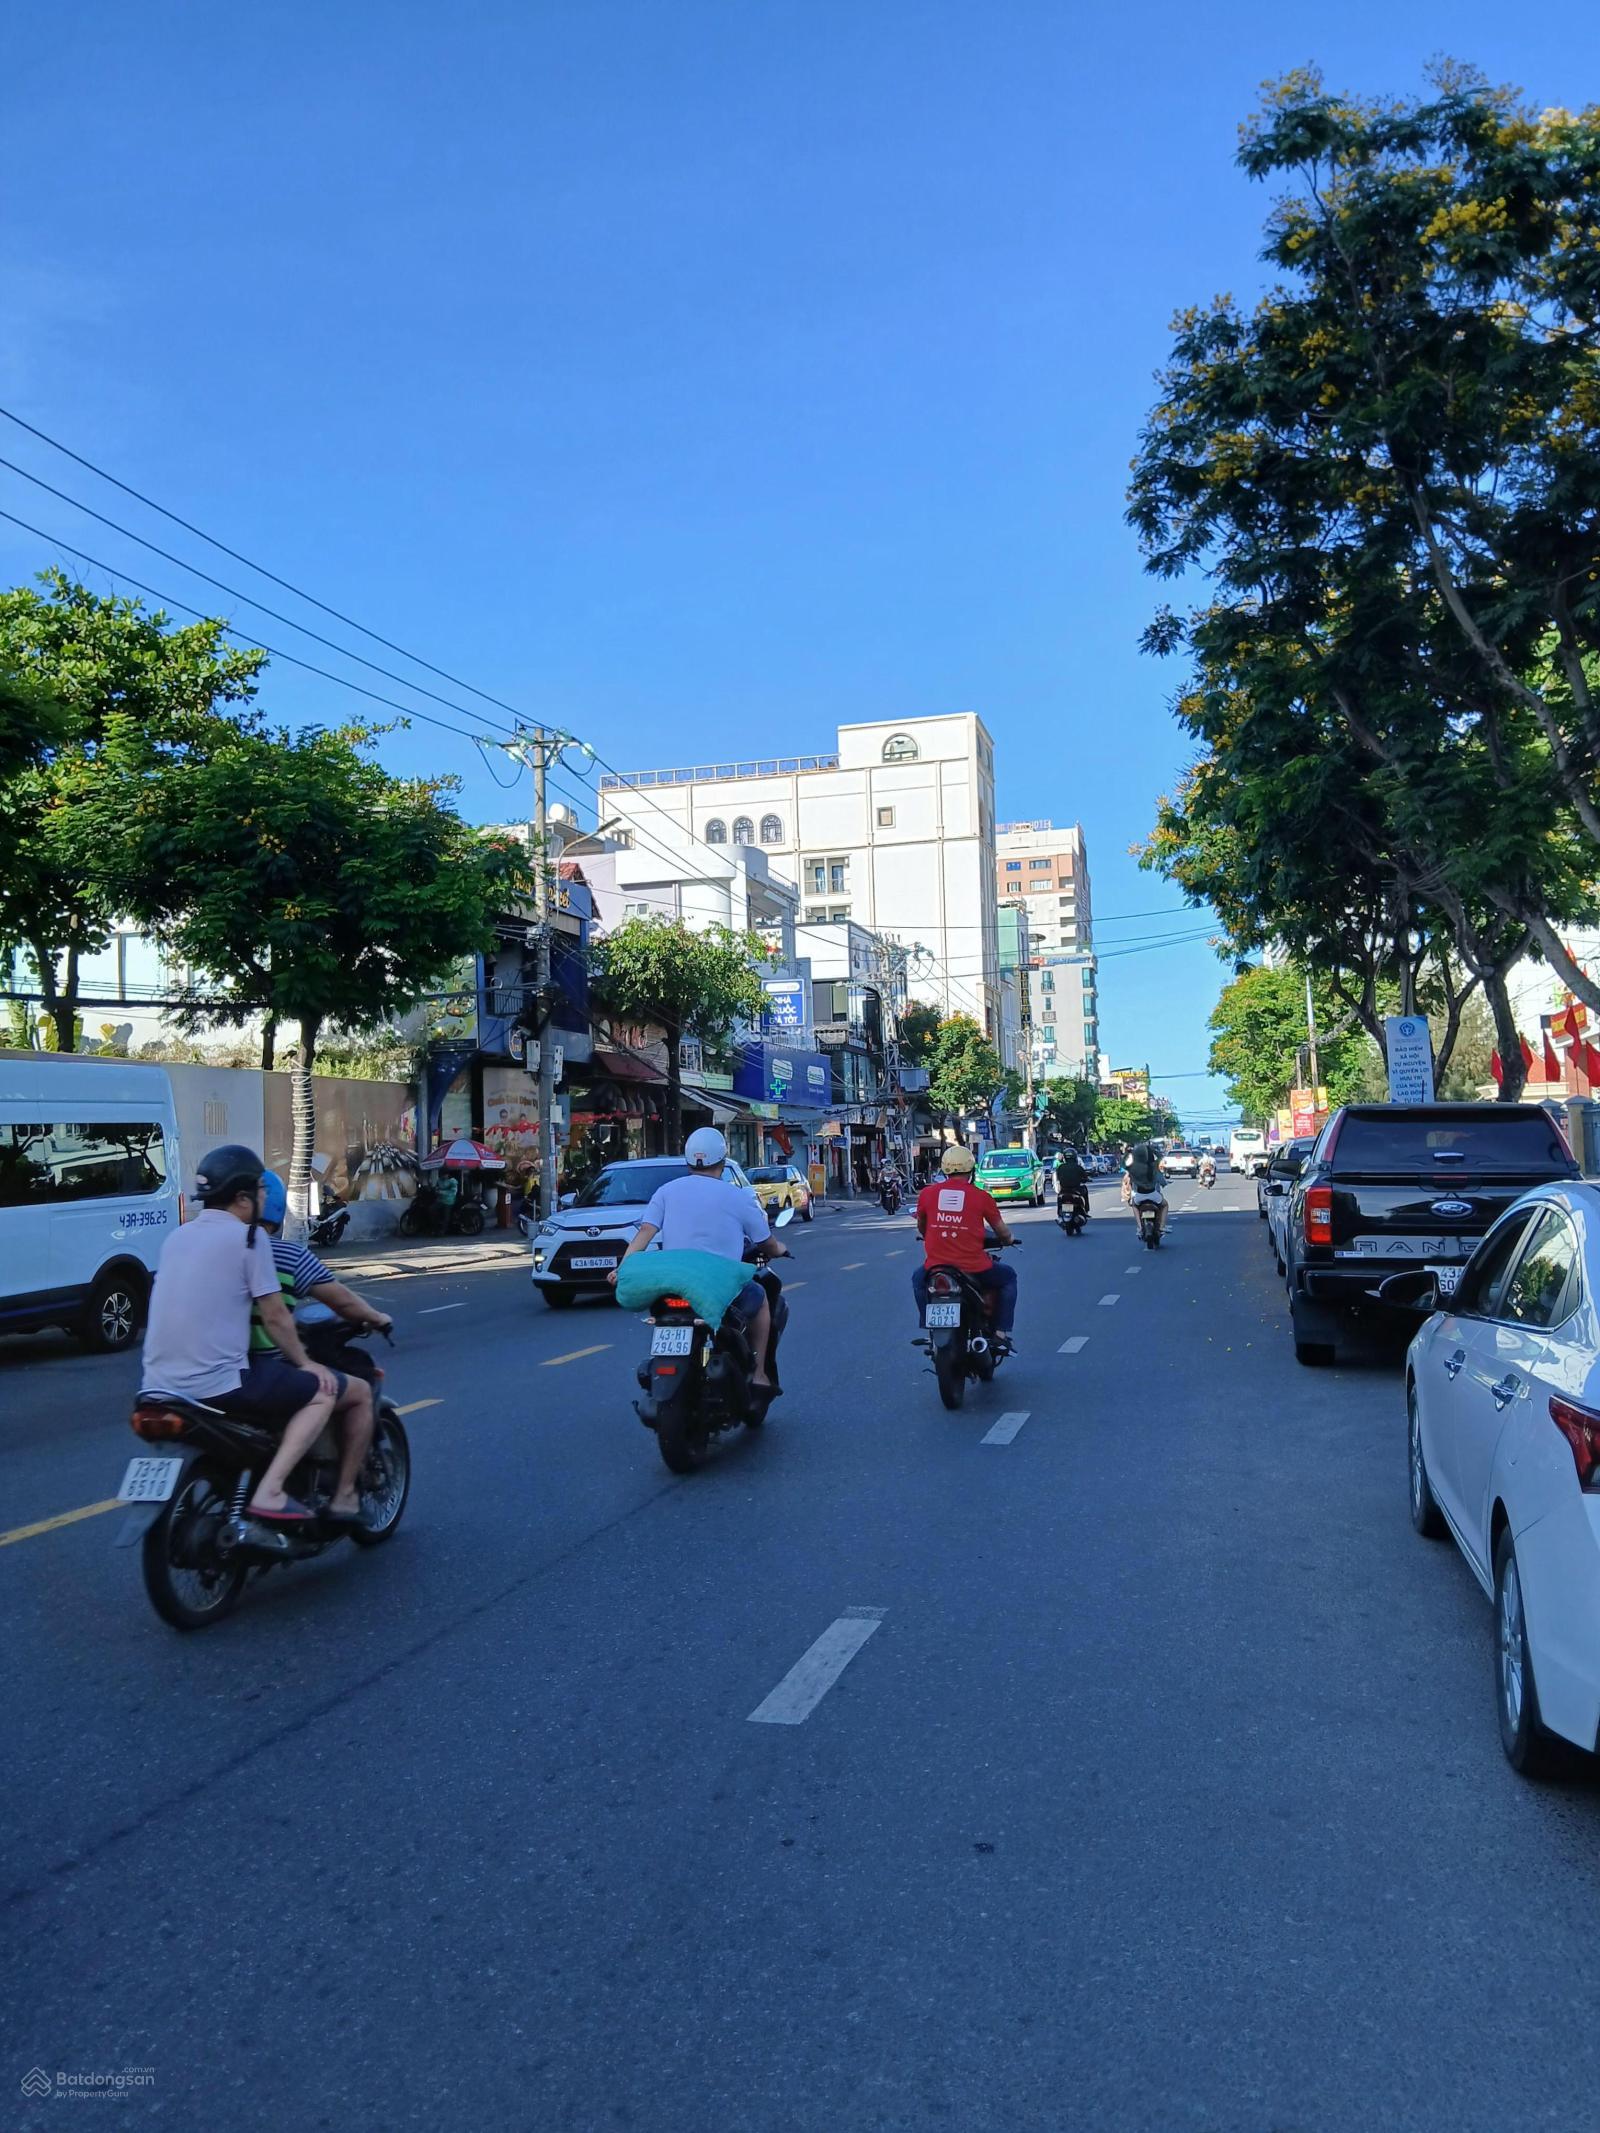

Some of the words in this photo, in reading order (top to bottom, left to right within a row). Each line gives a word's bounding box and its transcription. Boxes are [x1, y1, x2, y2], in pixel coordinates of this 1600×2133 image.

[119, 1210, 167, 1228] 43A-396.25
[937, 1213, 962, 1223] Now
[659, 1329, 686, 1340] 43-H1
[653, 1341, 689, 1354] 294.96
